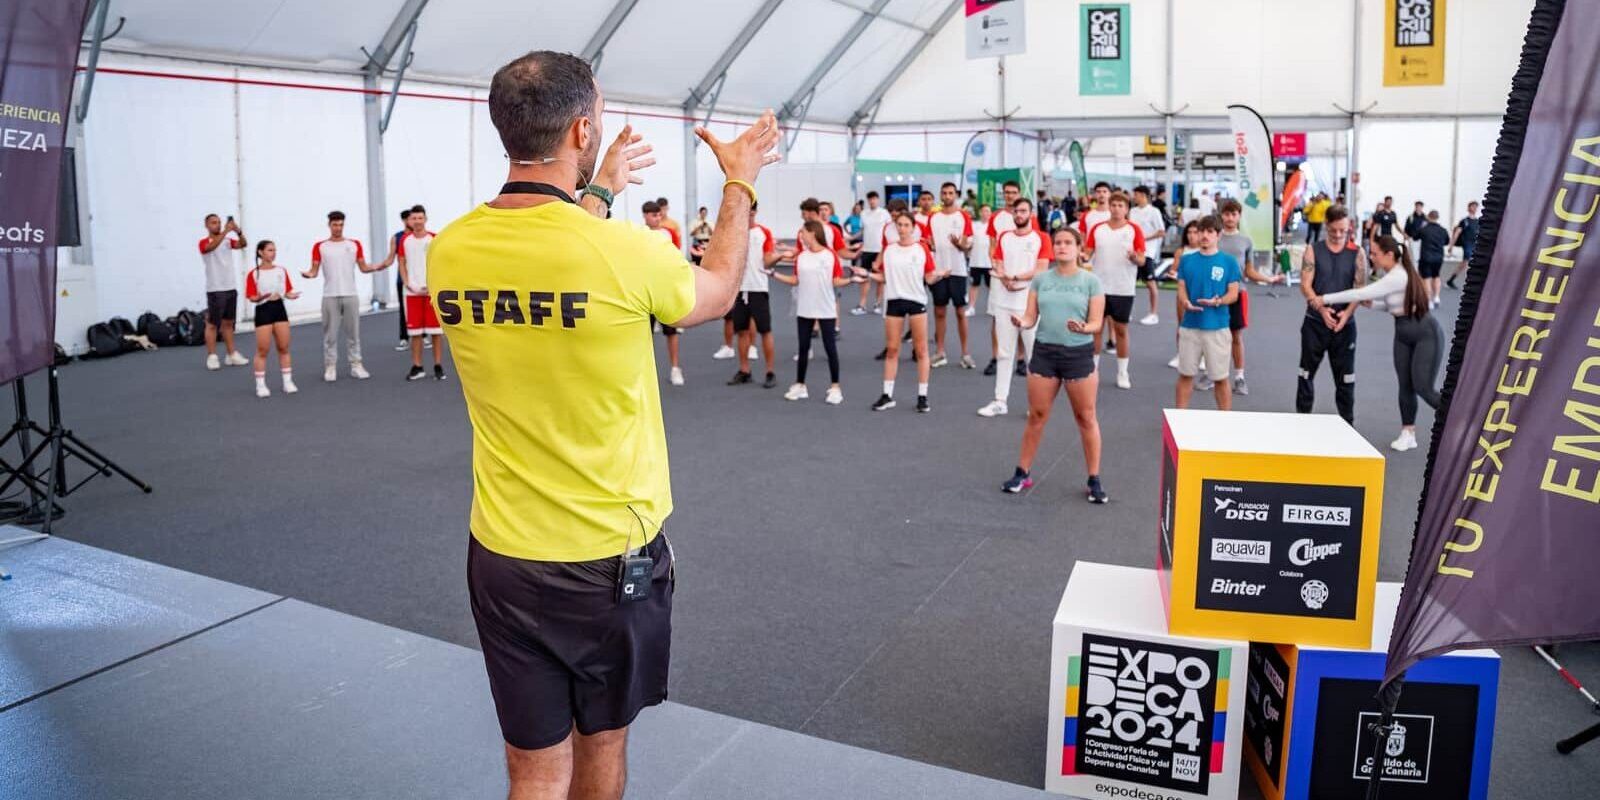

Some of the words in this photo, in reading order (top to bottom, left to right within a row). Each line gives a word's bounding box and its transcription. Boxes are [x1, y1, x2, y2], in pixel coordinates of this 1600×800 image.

[437, 290, 588, 328] STAFF
[1463, 136, 1600, 502] EXPERIENCIA
[1216, 541, 1266, 557] aquavia
[1289, 538, 1343, 566] Clipper
[1210, 578, 1266, 596] Binter
[1088, 643, 1211, 690] EXPO
[1086, 674, 1204, 722] DECA
[1086, 705, 1201, 752] 2024
[1085, 747, 1092, 755] la
[1092, 748, 1128, 761] Actividad
[1157, 759, 1170, 768] del
[1088, 739, 1123, 752] Congreso
[1123, 746, 1129, 754] y
[1128, 746, 1148, 756] Feria
[1148, 749, 1159, 758] de
[1084, 756, 1115, 768] Deporte
[1115, 762, 1126, 770] de
[1126, 763, 1160, 776] Canarias
[1175, 757, 1198, 768] 14/17
[1175, 765, 1197, 777] NOV
[1385, 766, 1422, 777] Canaria
[1403, 759, 1417, 768] de
